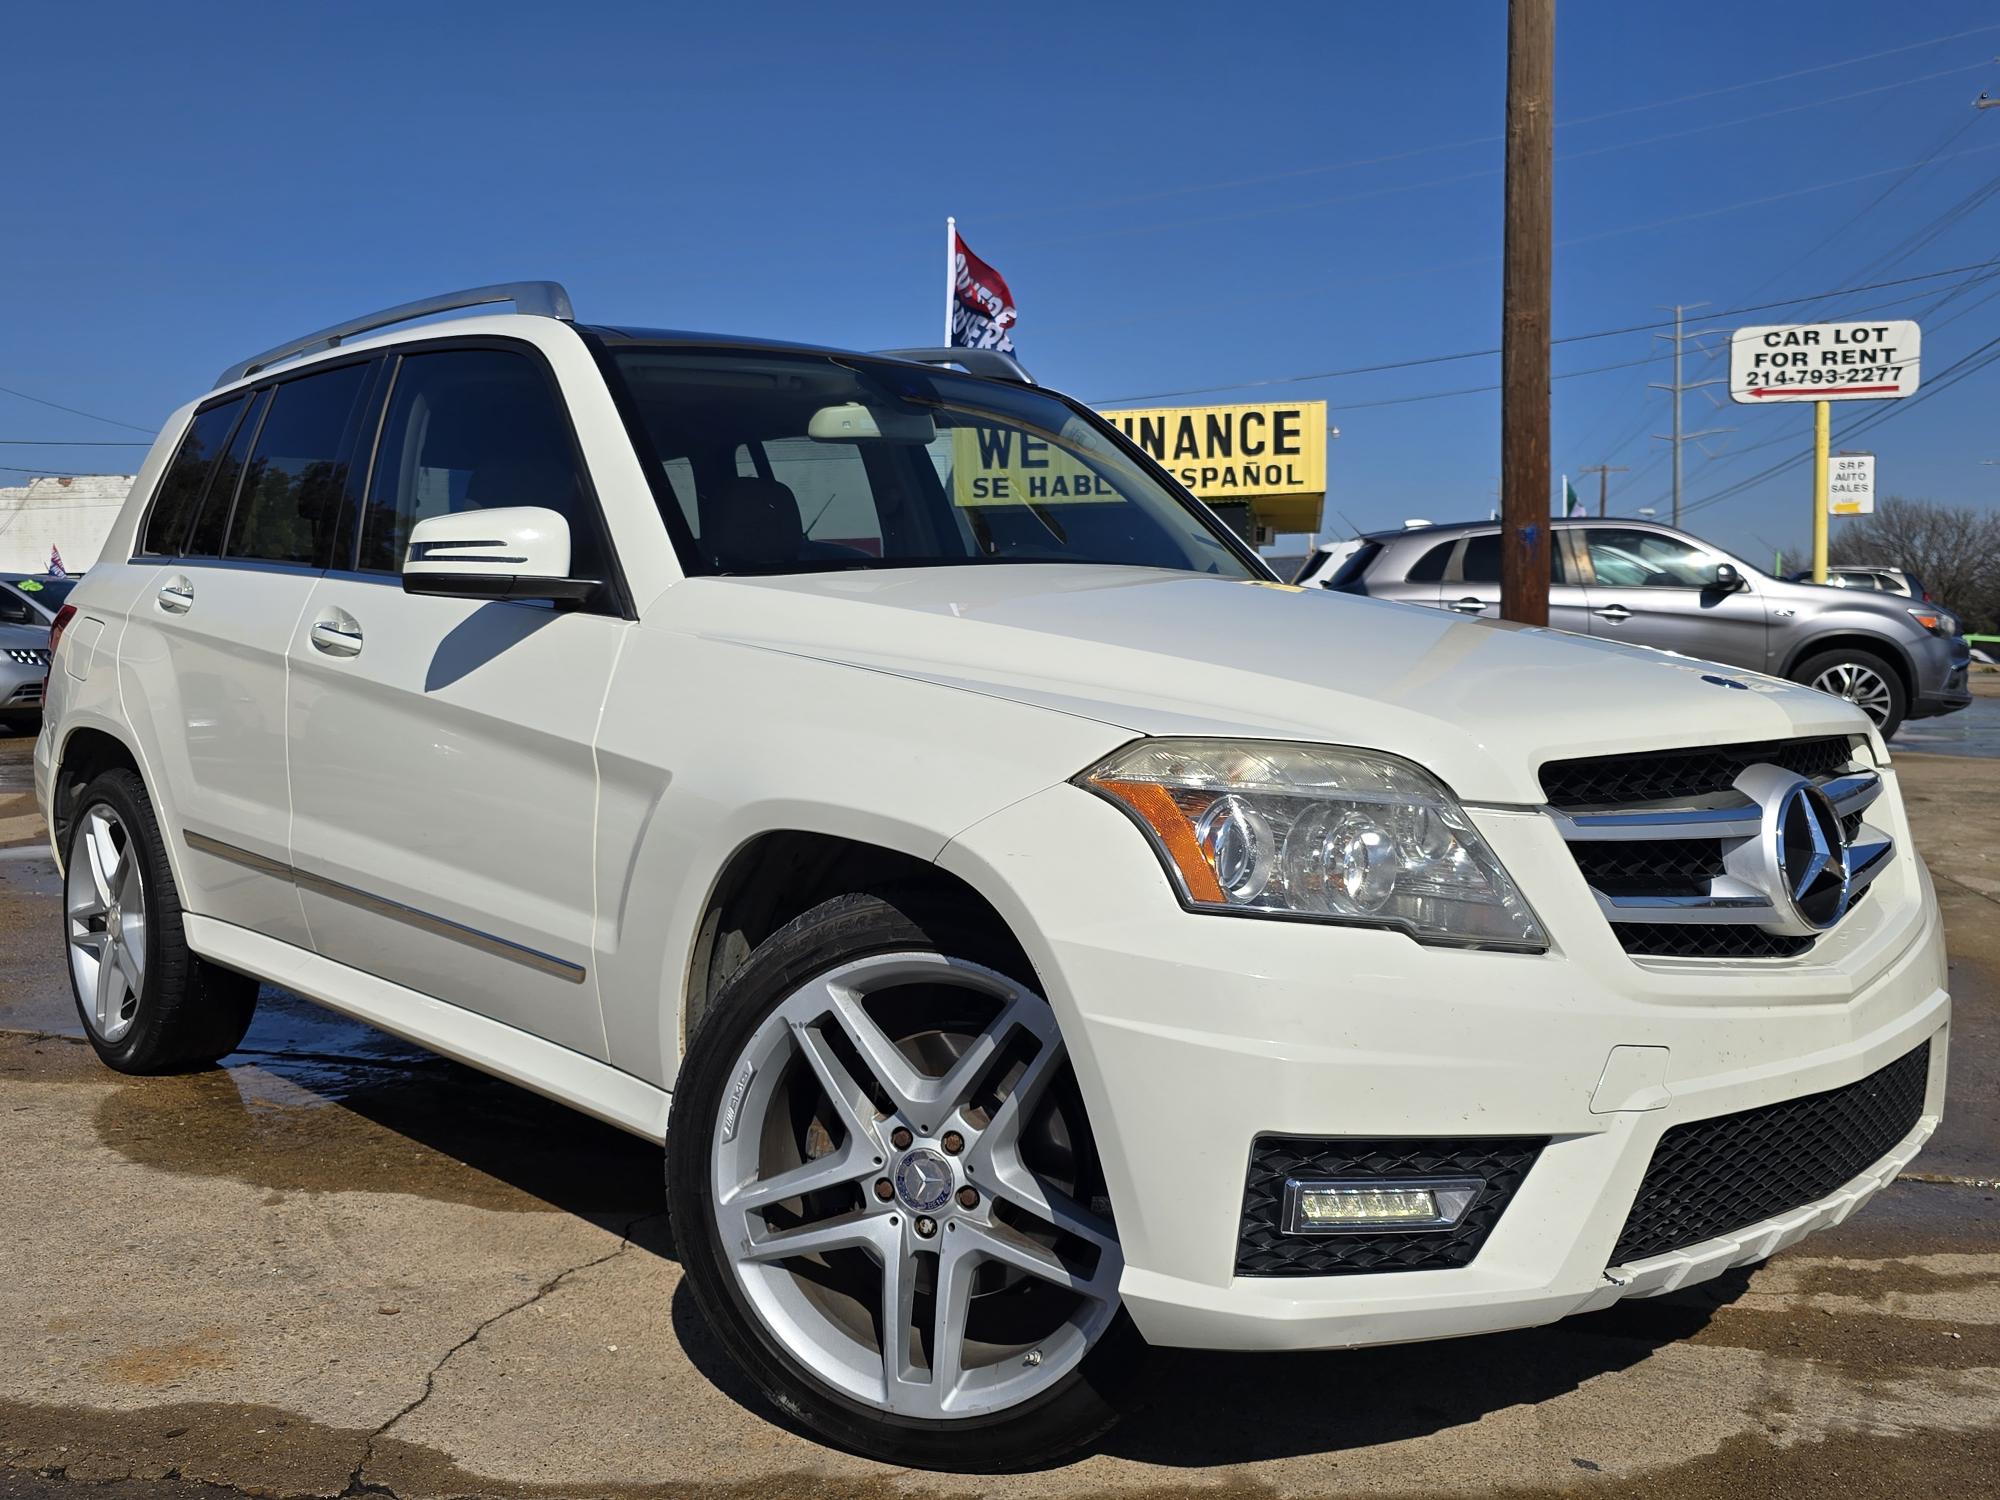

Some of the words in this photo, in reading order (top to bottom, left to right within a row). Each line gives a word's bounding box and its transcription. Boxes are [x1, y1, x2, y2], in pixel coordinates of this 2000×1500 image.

[1763, 330, 1820, 348] CAR
[1834, 327, 1889, 345] LOT
[1754, 352, 1808, 368] FOR
[1821, 348, 1897, 366] RENT
[1746, 367, 1904, 386] 214-793-2277
[976, 428, 1049, 470] WE
[1107, 411, 1301, 461] NANCE
[973, 477, 1010, 498] SE
[1029, 474, 1114, 498] HABL
[1168, 461, 1304, 489] SPAÑOL
[1835, 472, 1867, 482] AUTO
[1831, 483, 1869, 493] SALES
